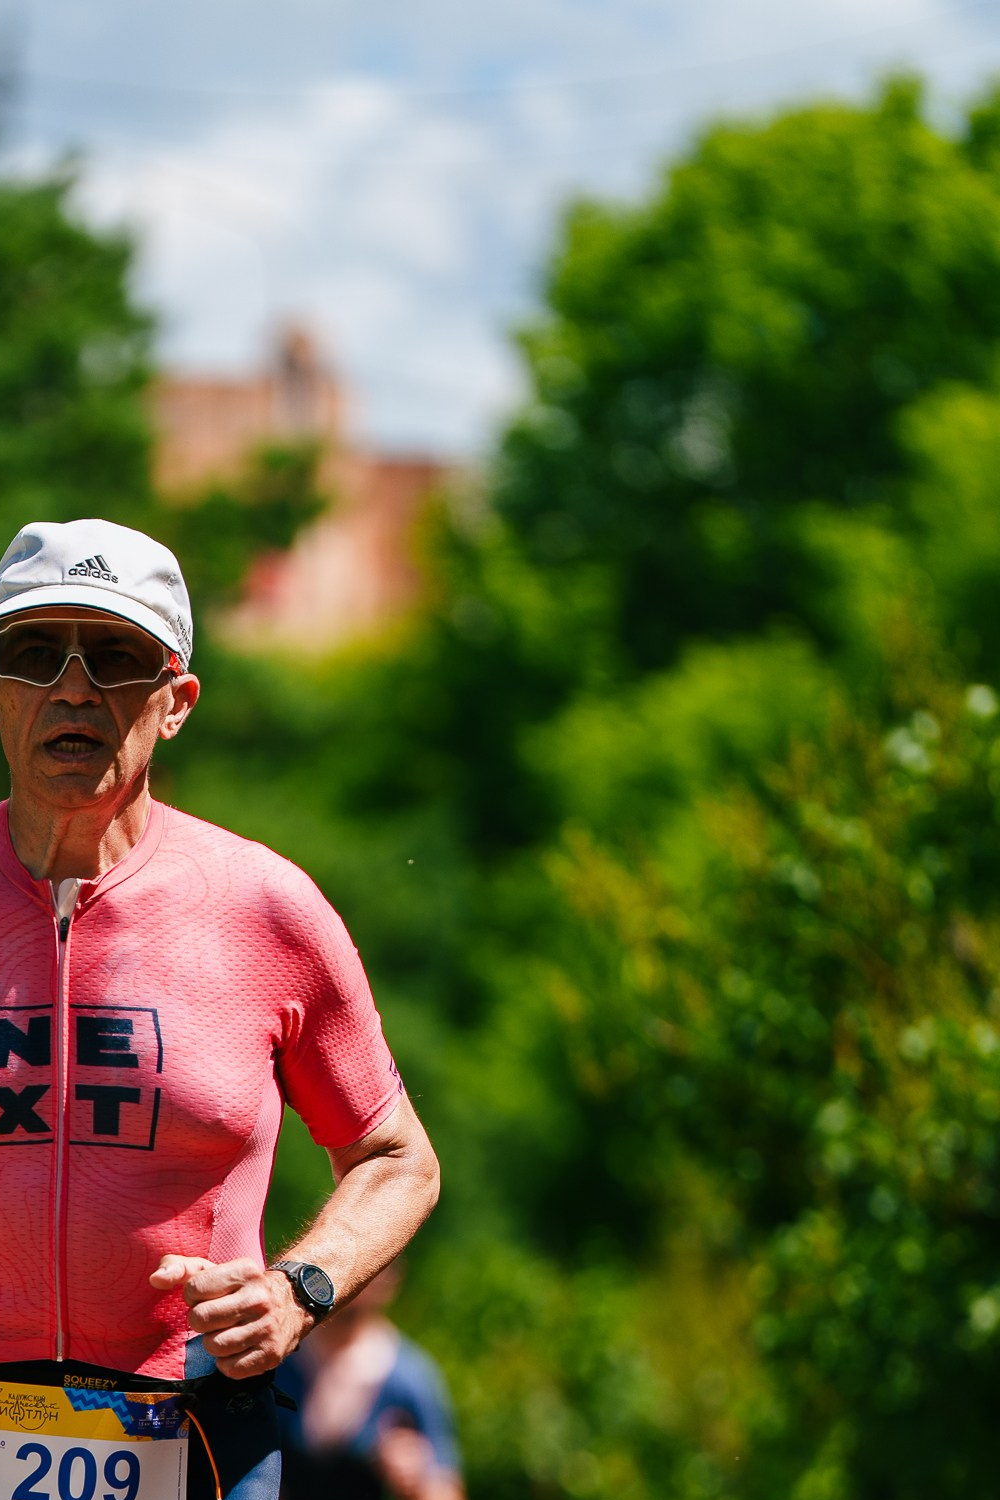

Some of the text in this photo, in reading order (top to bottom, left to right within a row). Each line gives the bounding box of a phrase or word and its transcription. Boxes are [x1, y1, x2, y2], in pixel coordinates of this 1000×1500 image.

[68, 565, 119, 584] adidas
[63, 1374, 118, 1388] SQUEEZY
[8, 1393, 46, 1402] КАЛУЖСКИЙ
